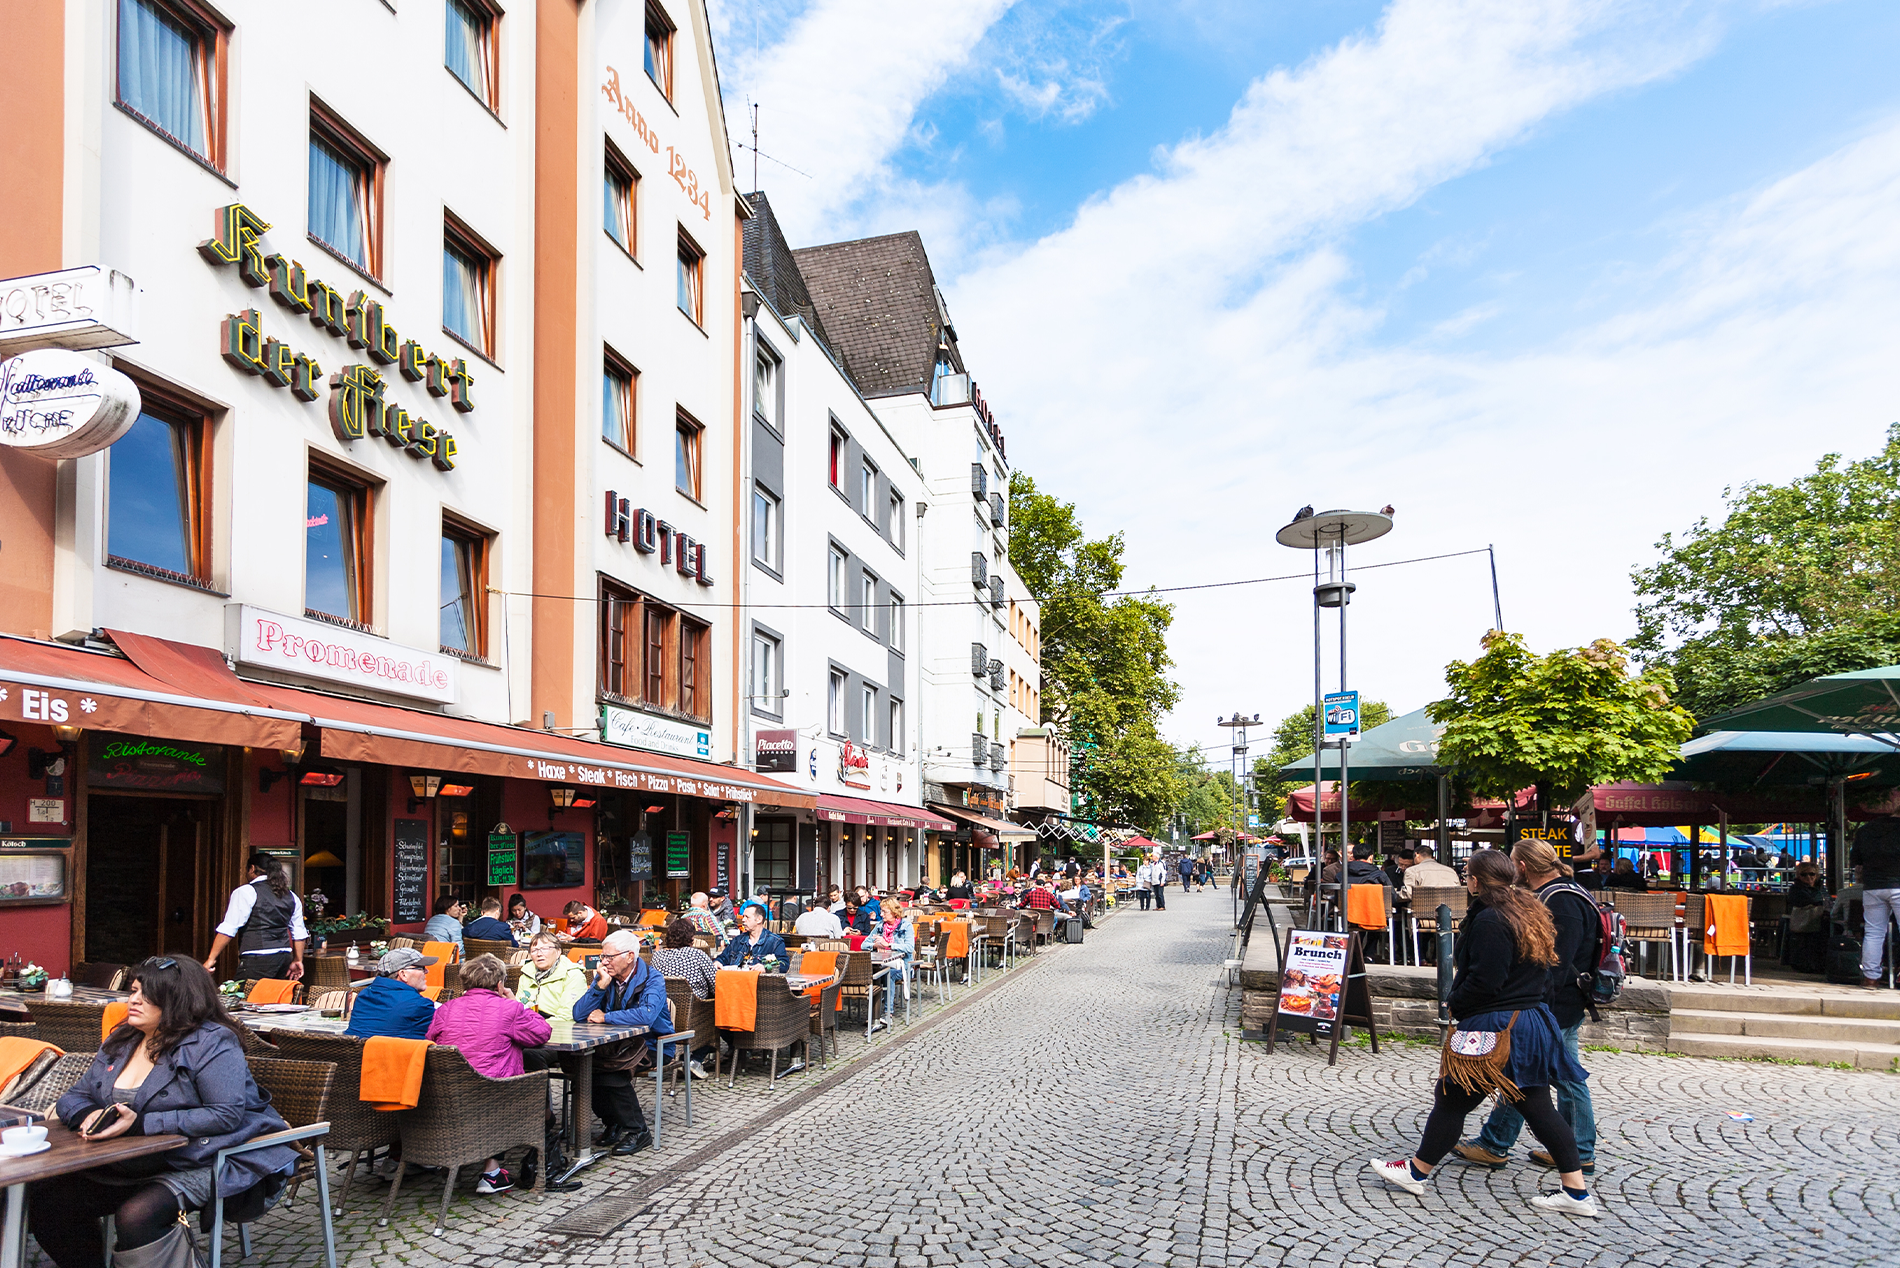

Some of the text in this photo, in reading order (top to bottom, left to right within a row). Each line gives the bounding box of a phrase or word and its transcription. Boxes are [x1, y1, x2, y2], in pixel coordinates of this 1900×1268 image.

[601, 65, 711, 222] Anno 1234
[0, 282, 94, 325] OTEL
[196, 203, 474, 412] Kunibert
[221, 308, 457, 471] der Fiese
[972, 382, 1007, 460] HOTEL
[605, 490, 714, 586] HOTEL
[256, 618, 448, 689] Promenade
[22, 688, 69, 722] Eis
[103, 741, 206, 766] Ristorante
[630, 735, 679, 752] Food and Drinks
[758, 739, 794, 750] Piacetto
[107, 762, 201, 787] Pizzeria
[538, 761, 753, 801] Haxe Steak Fisch Pizza Pasta Salat Frühstück
[1605, 795, 1647, 810] Gaffel
[1521, 828, 1568, 840] STEAK
[490, 851, 516, 865] Frühstück
[492, 865, 514, 877] täglich
[1294, 946, 1342, 960] Brunch
